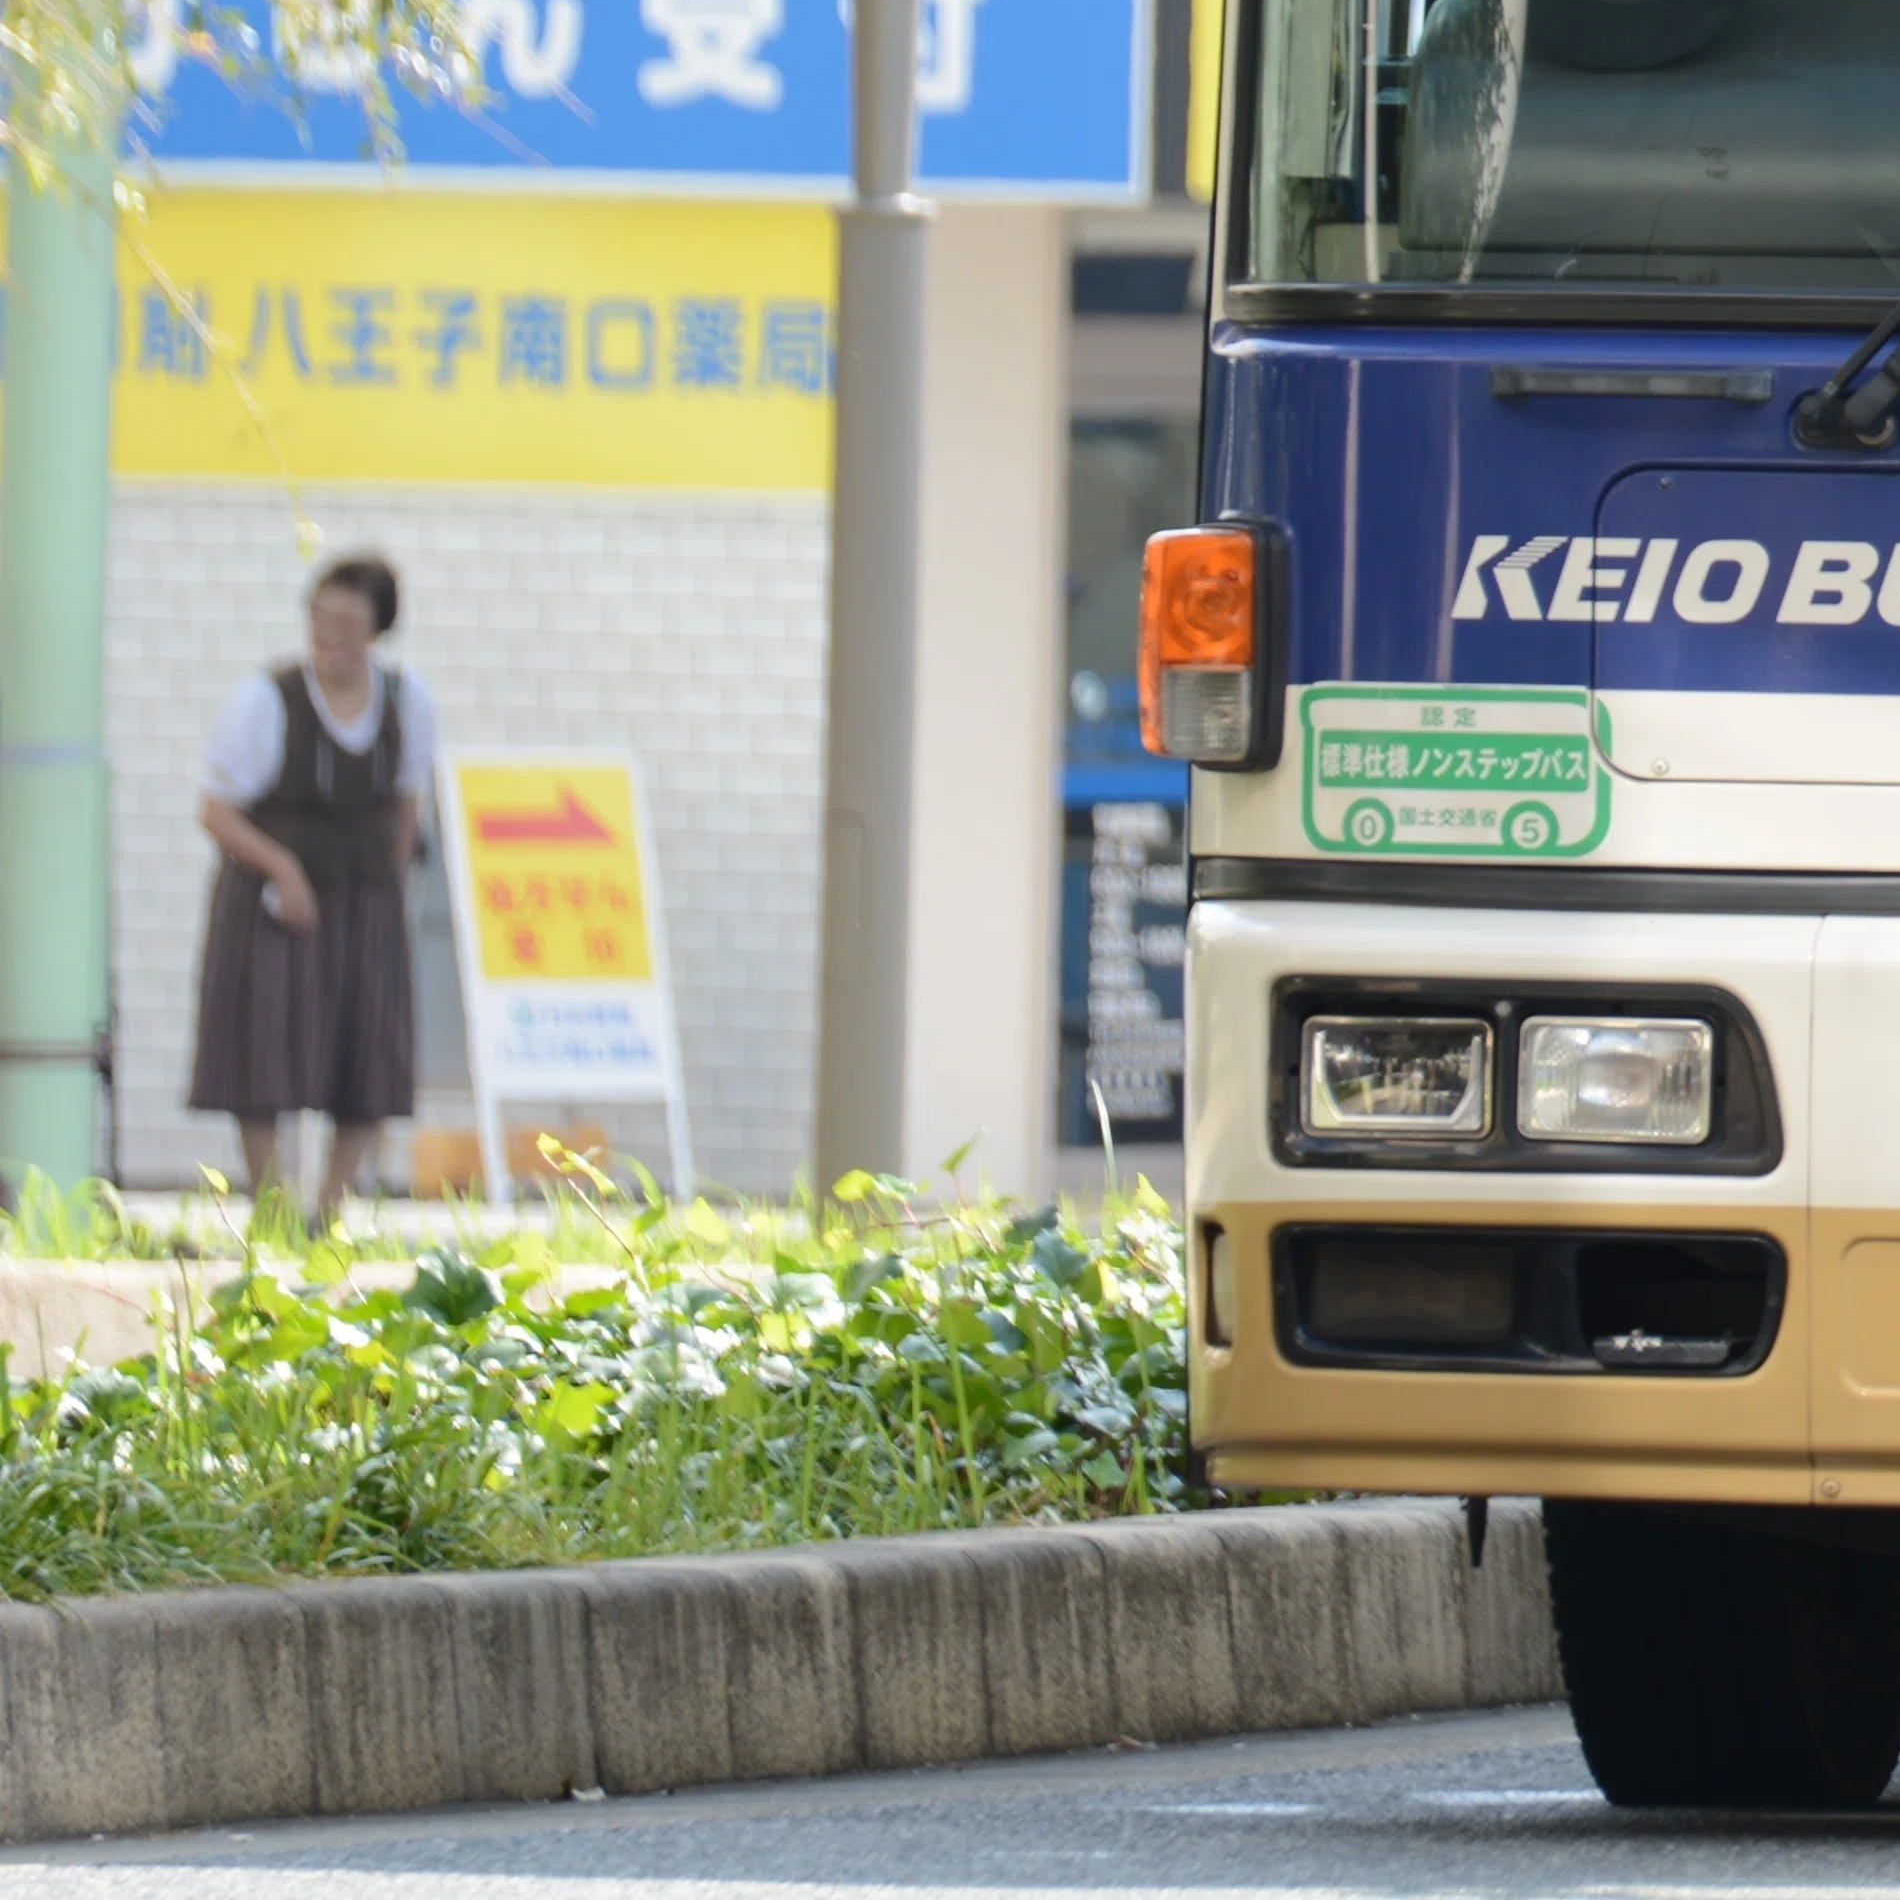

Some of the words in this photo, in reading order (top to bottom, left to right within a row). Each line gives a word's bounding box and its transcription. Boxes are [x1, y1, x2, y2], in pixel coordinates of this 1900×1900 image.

[1450, 534, 1772, 624] KEIO
[1320, 742, 1588, 782] 標準仕様ノンステップバス
[1358, 814, 1378, 841] 0
[1520, 819, 1541, 845] 5
